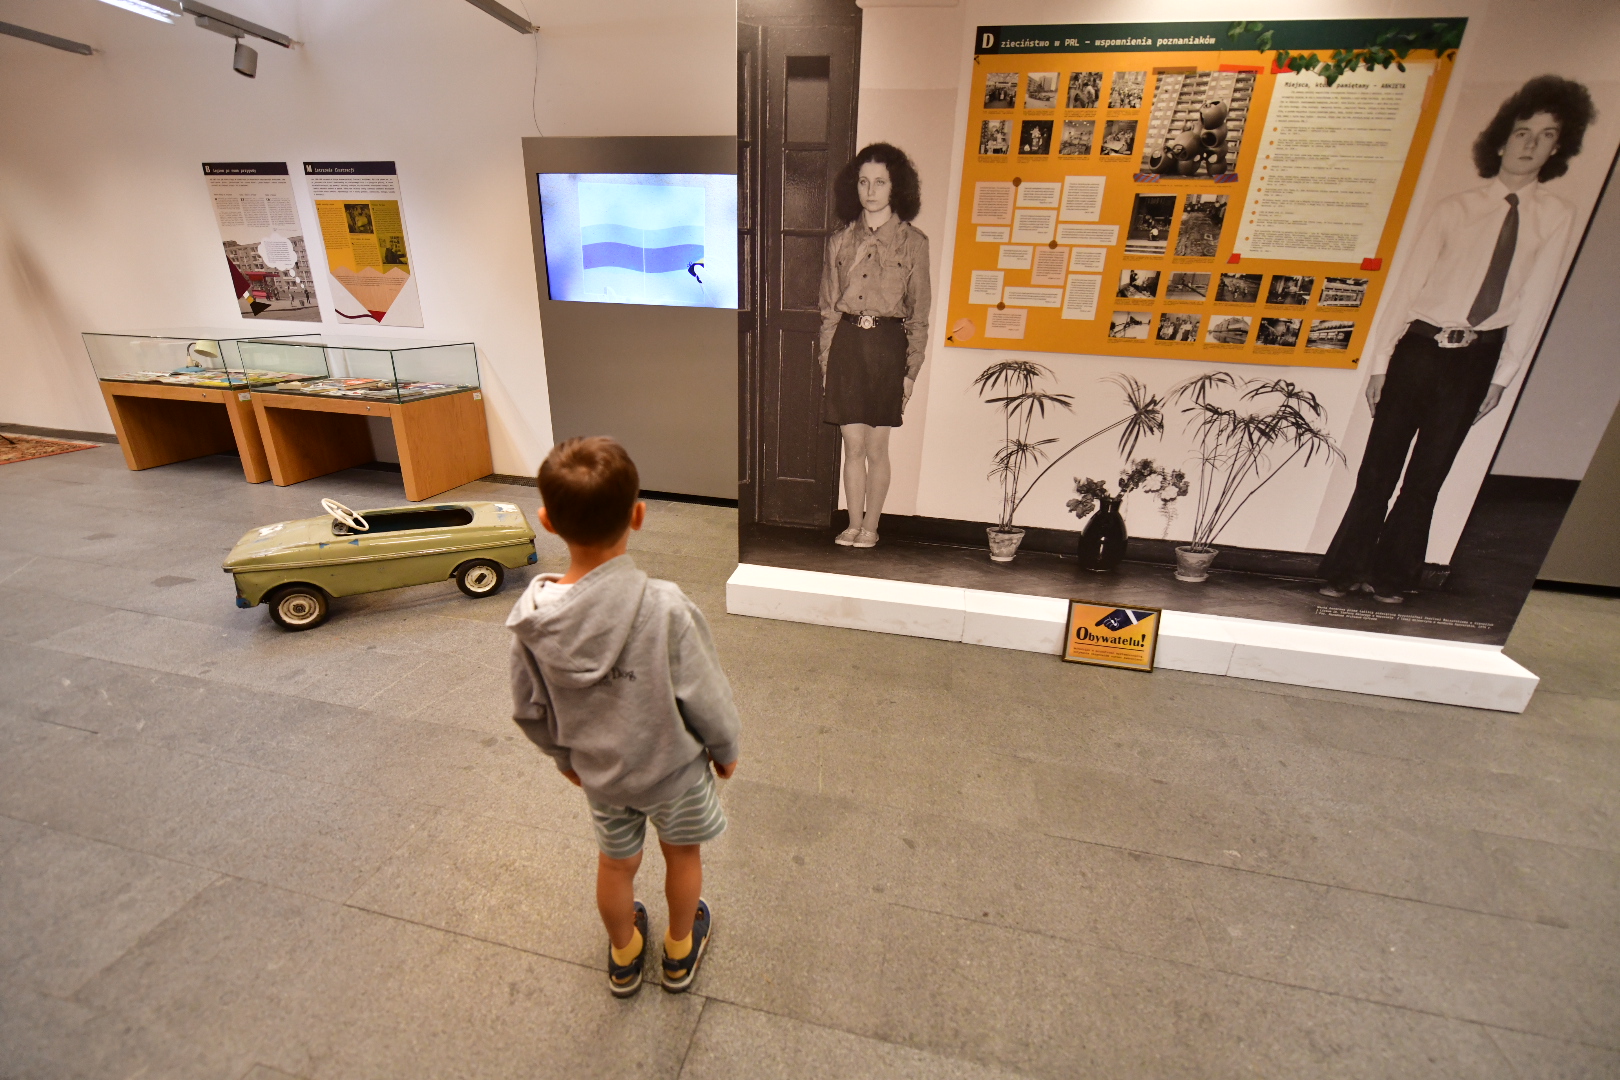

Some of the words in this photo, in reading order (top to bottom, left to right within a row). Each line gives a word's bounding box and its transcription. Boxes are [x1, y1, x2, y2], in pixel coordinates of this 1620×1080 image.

[982, 33, 994, 48] D
[1001, 38, 1050, 48] zieciństwo
[1064, 38, 1080, 47] PRL
[1095, 37, 1152, 47] wspomnienia
[1156, 35, 1217, 47] poznaniaków
[1076, 626, 1146, 647] Obywatelu!
